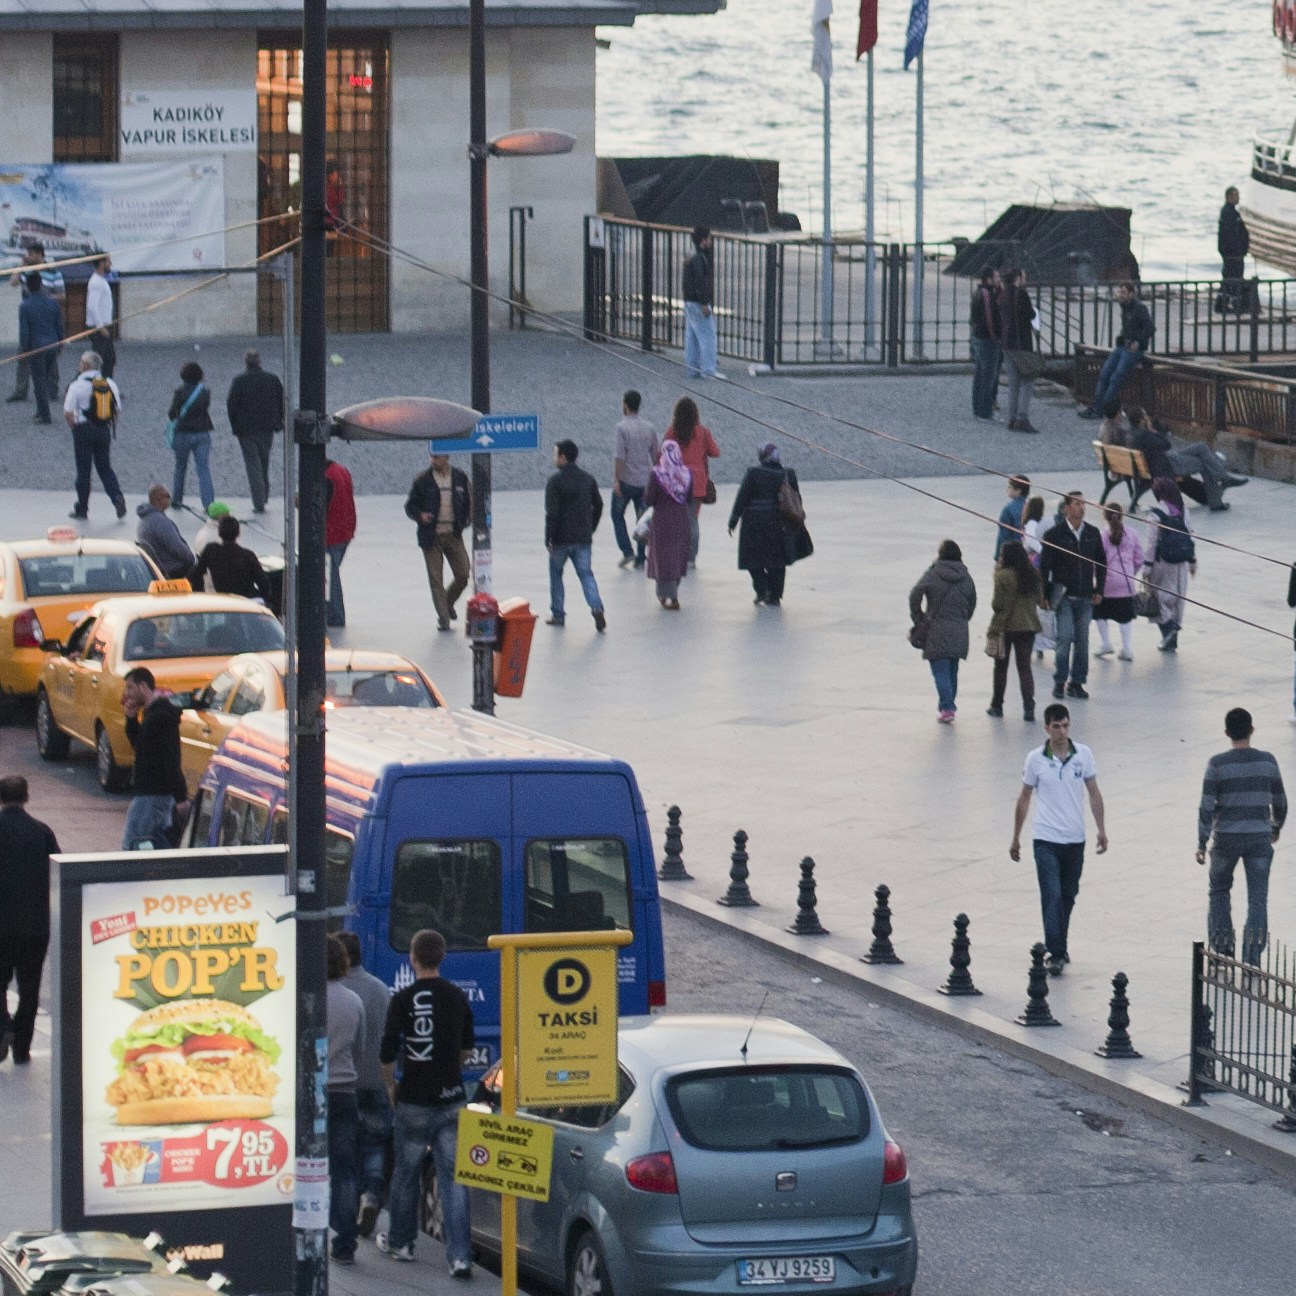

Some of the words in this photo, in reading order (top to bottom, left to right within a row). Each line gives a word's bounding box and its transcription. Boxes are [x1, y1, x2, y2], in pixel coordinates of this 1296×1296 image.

[153, 104, 224, 122] KADIKÖY
[121, 129, 176, 144] VAPUR
[182, 124, 255, 144] İSKELESİ
[131, 920, 260, 950] CHICKEN
[557, 968, 583, 995] D
[406, 990, 434, 1062] Klein
[538, 1006, 598, 1027] TAKSİ
[561, 1032, 586, 1040] ARAÇ
[506, 1125, 533, 1138] ARAÇ
[184, 1243, 224, 1261] Wall
[747, 1261, 765, 1278] 34
[793, 1258, 831, 1276] 9259
